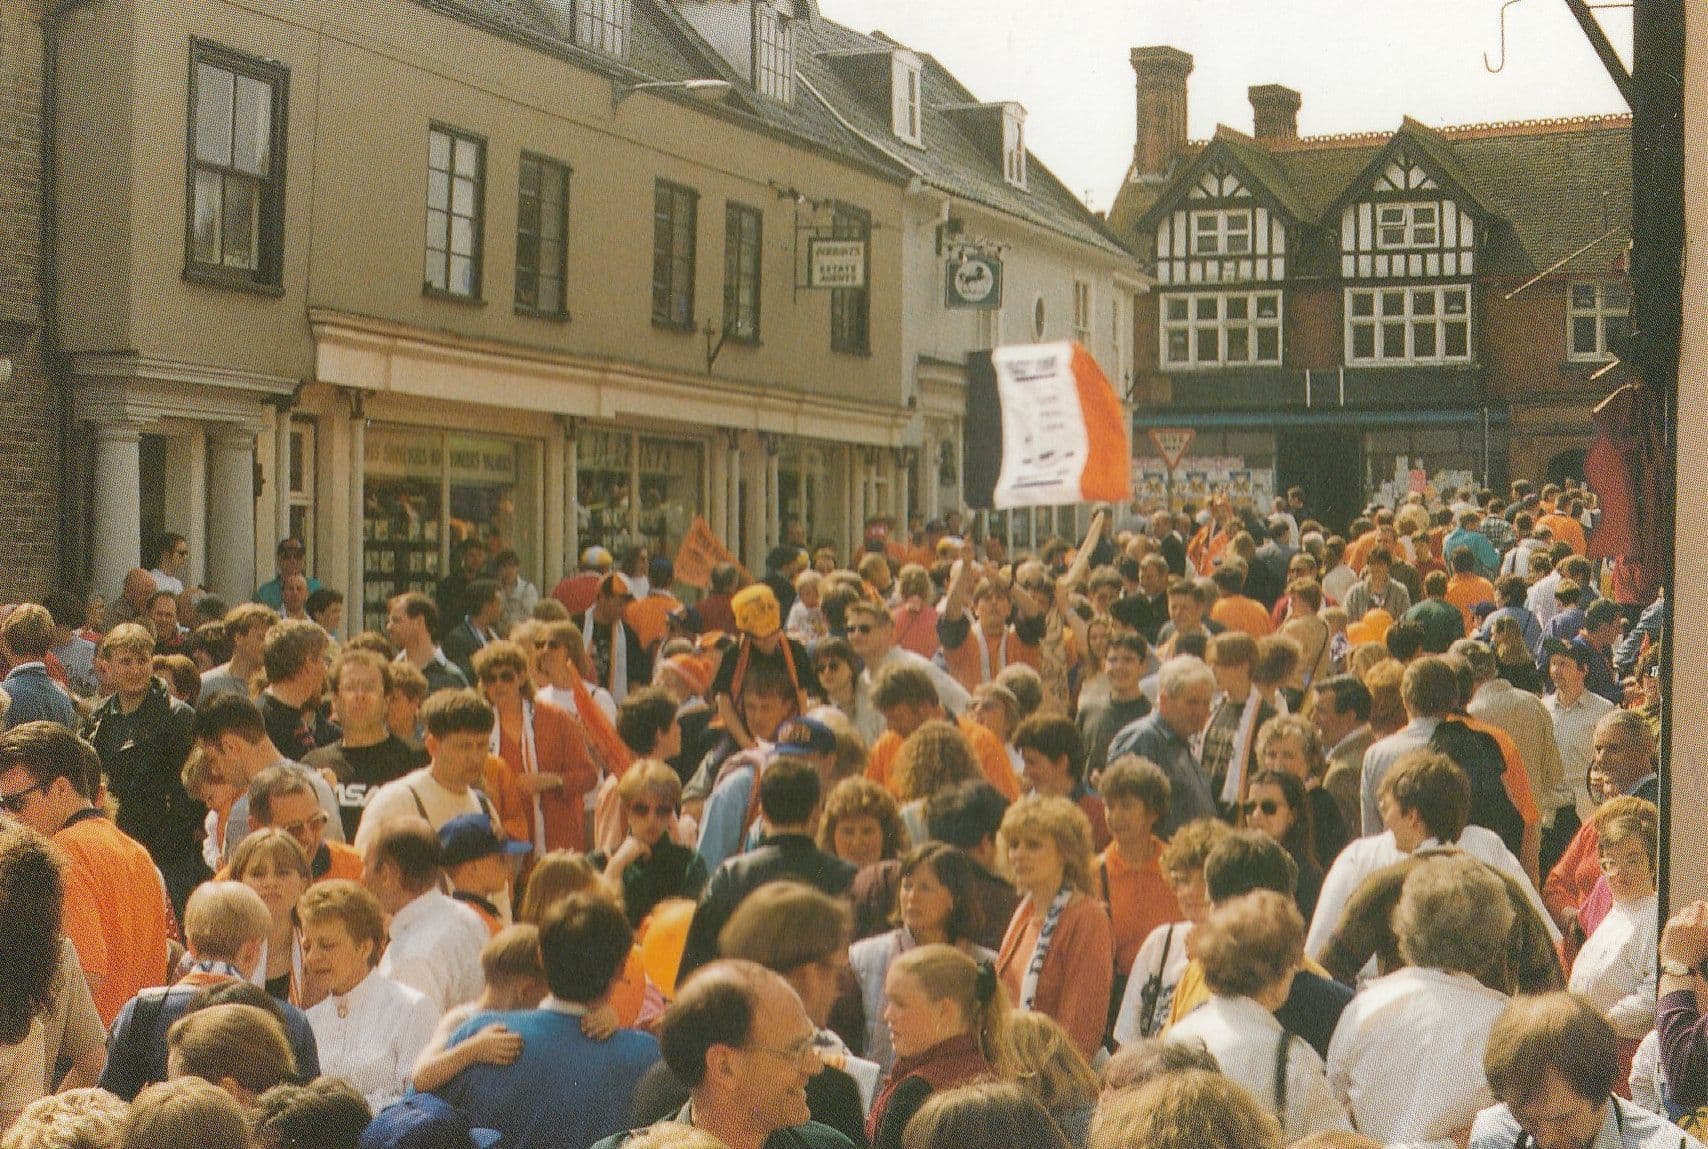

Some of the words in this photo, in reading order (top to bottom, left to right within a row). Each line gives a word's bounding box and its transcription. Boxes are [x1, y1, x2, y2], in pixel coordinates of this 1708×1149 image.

[820, 265, 857, 274] ESTATE
[820, 274, 857, 282] AGENTS
[1160, 433, 1184, 442] GIVE
